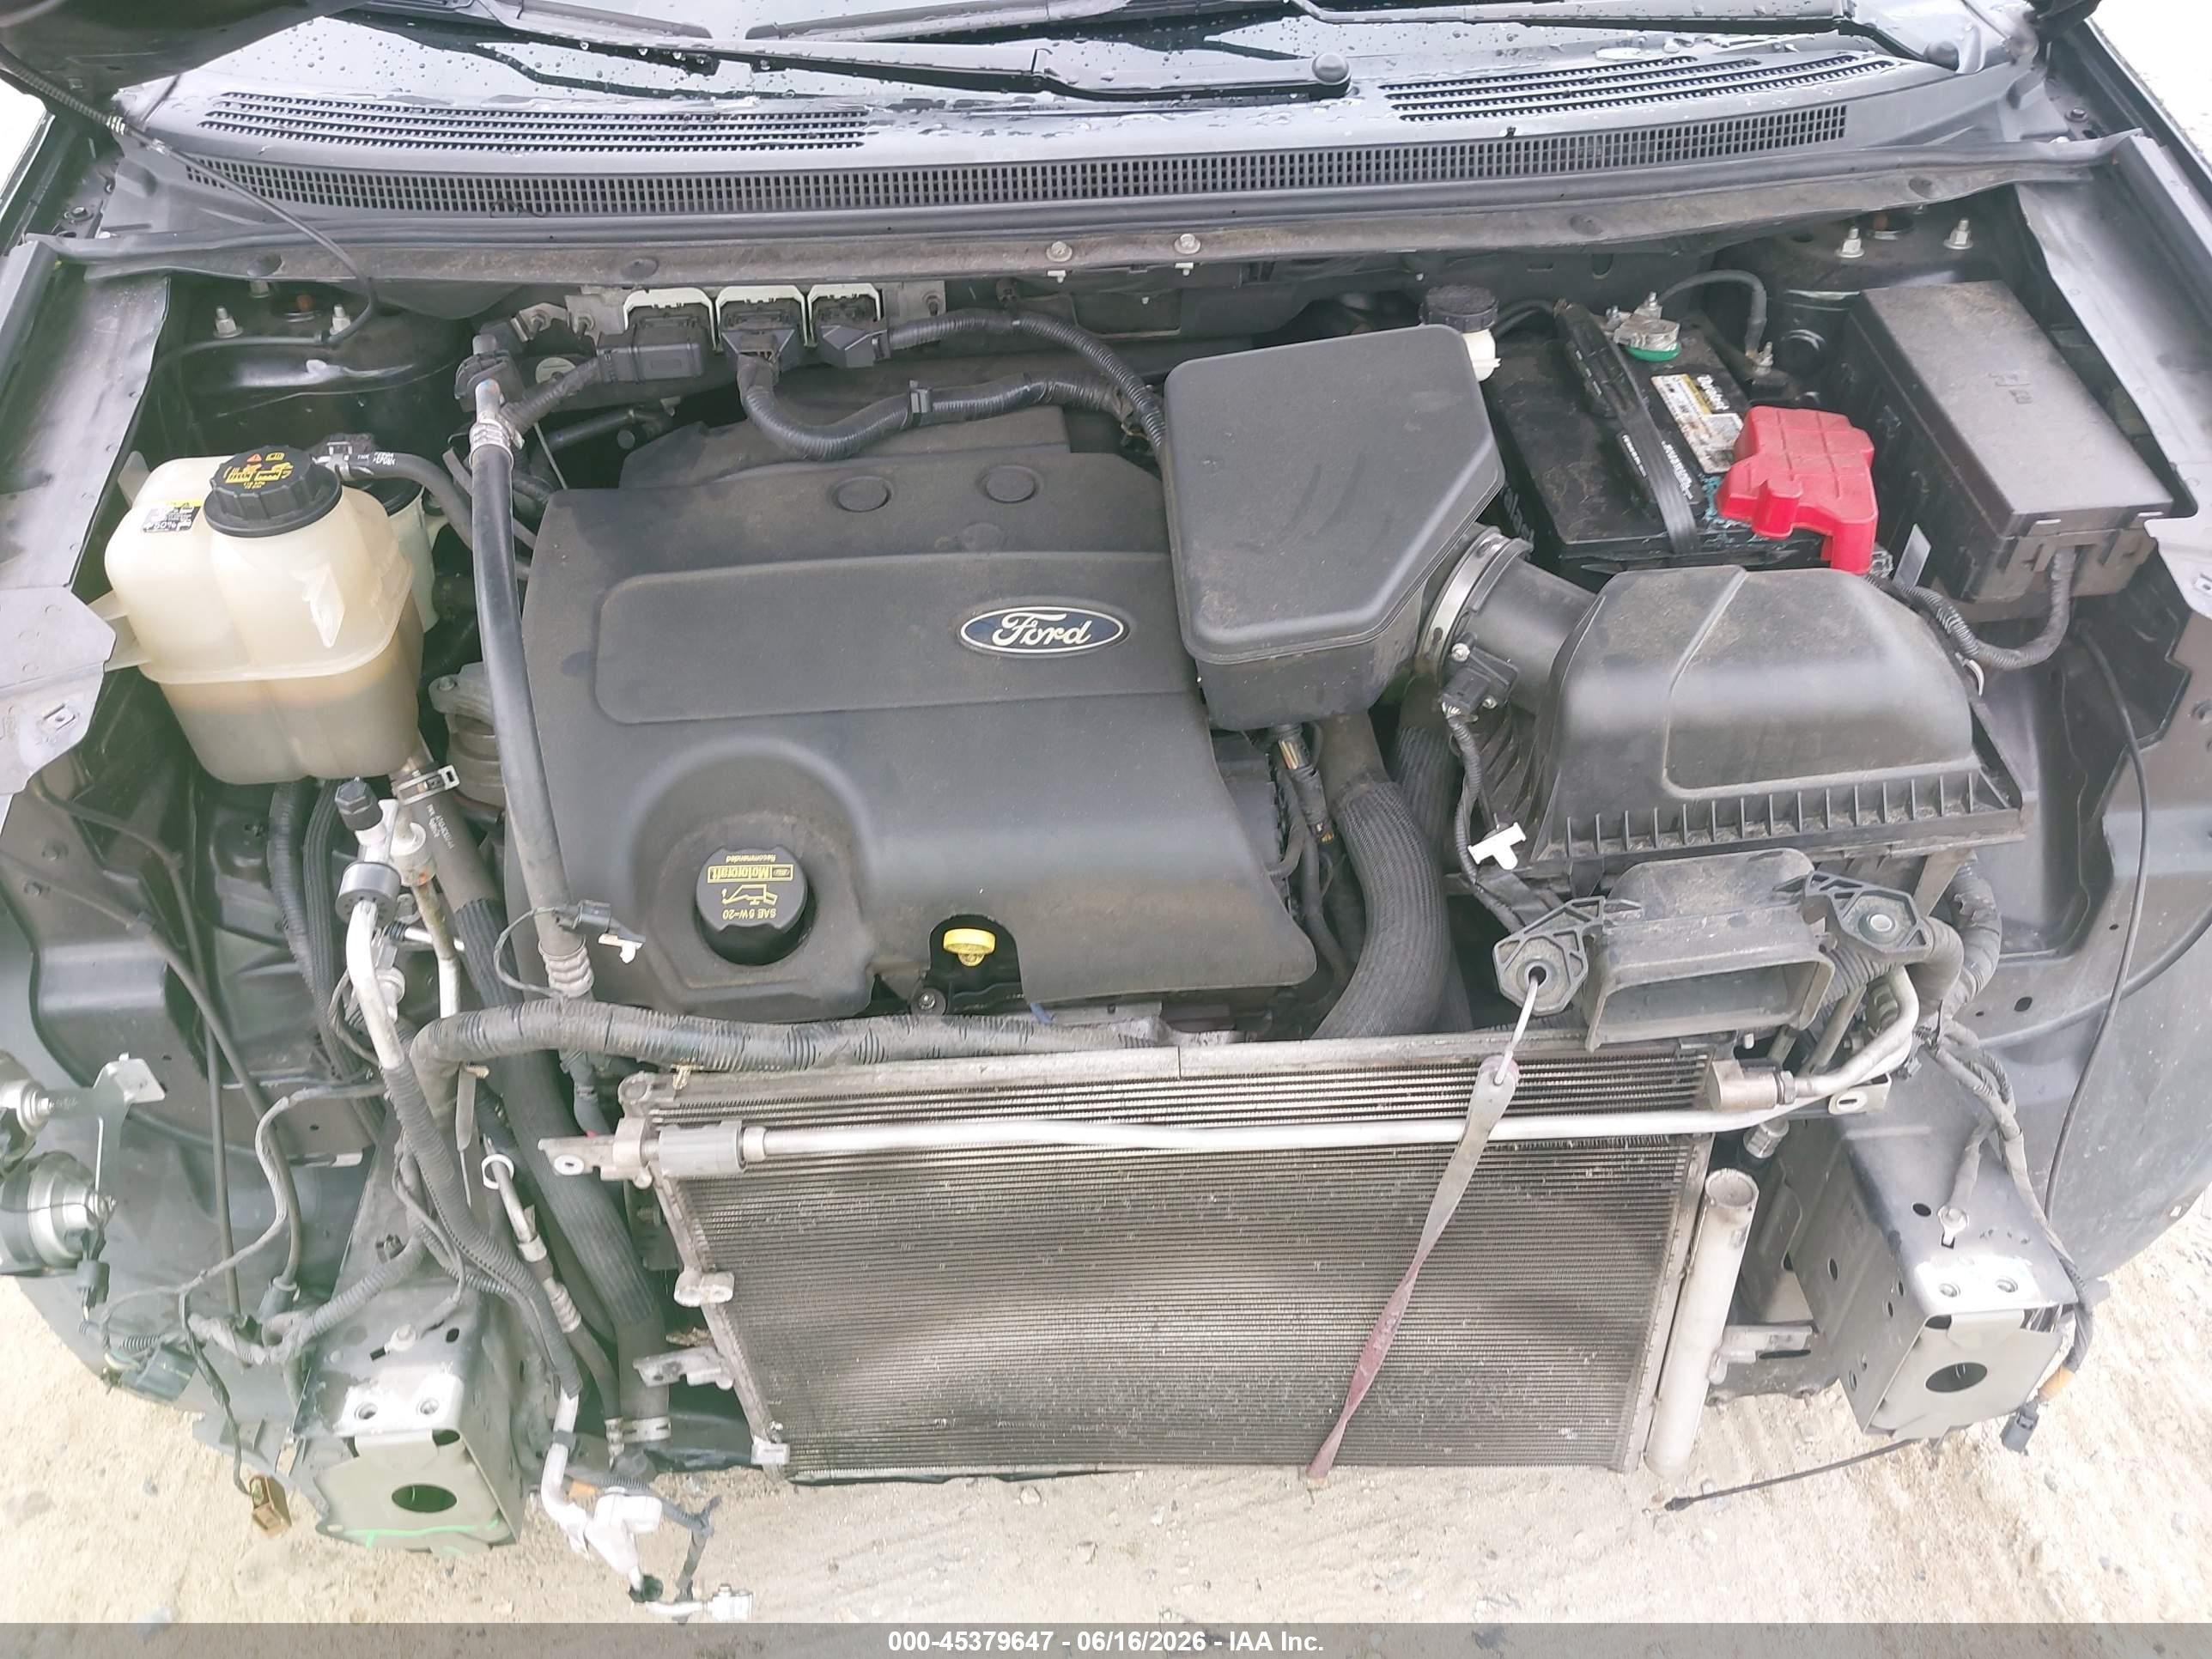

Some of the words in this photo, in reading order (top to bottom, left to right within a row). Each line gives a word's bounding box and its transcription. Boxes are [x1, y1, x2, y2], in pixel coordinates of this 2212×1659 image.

[992, 612, 1093, 647] Ford
[712, 866, 770, 880] Motorcraft
[757, 908, 777, 919] SAE
